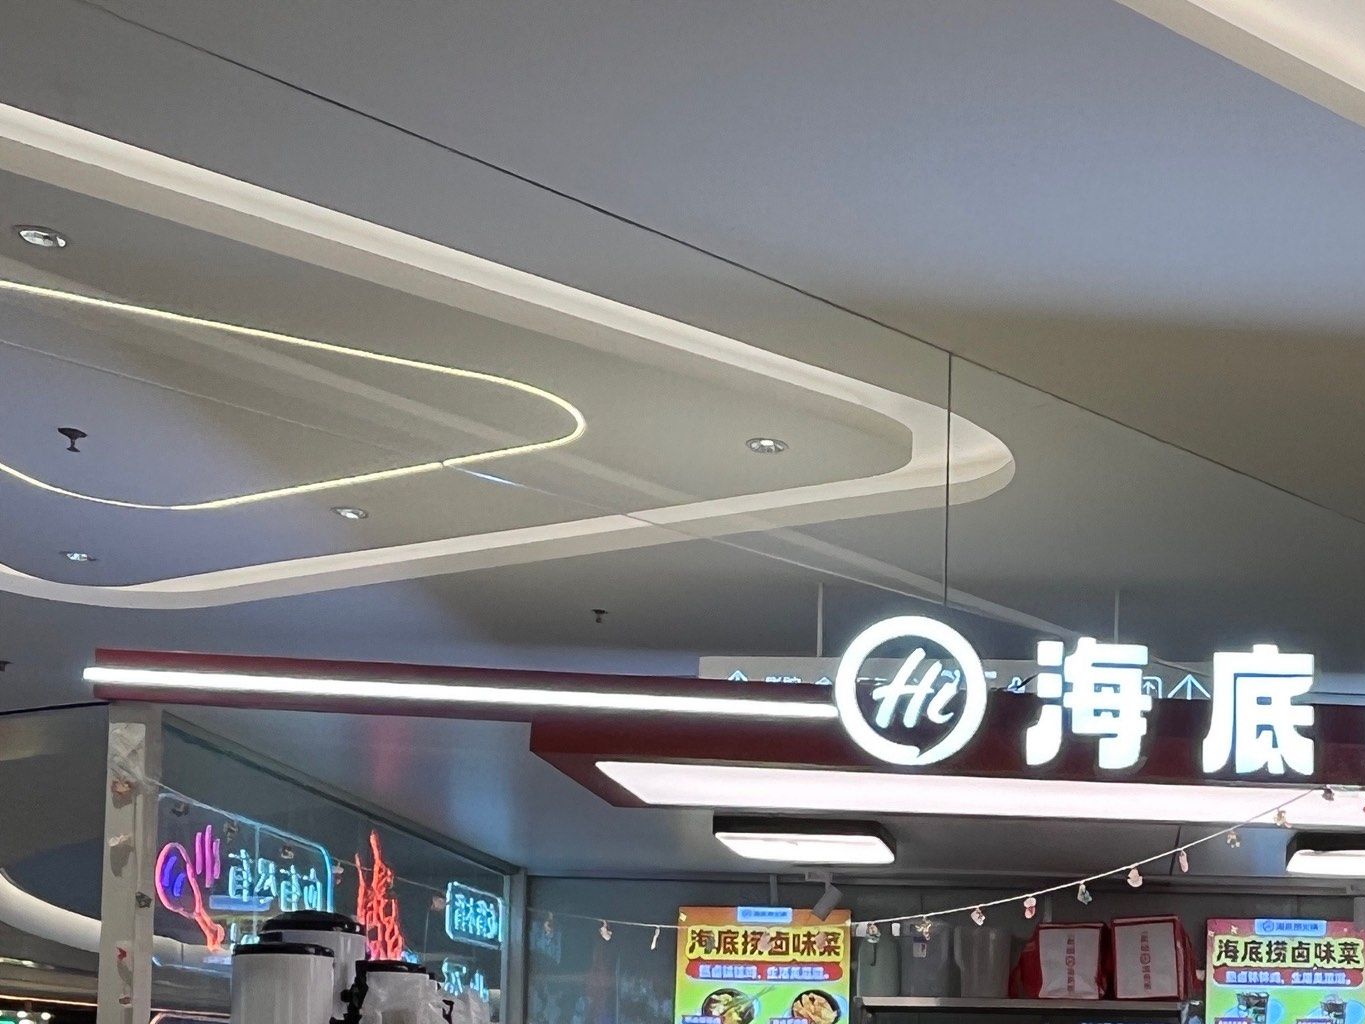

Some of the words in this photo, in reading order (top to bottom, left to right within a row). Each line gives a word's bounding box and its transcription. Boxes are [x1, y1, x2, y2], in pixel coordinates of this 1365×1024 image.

[1216, 939, 1361, 964] 海底捞卤味菜
